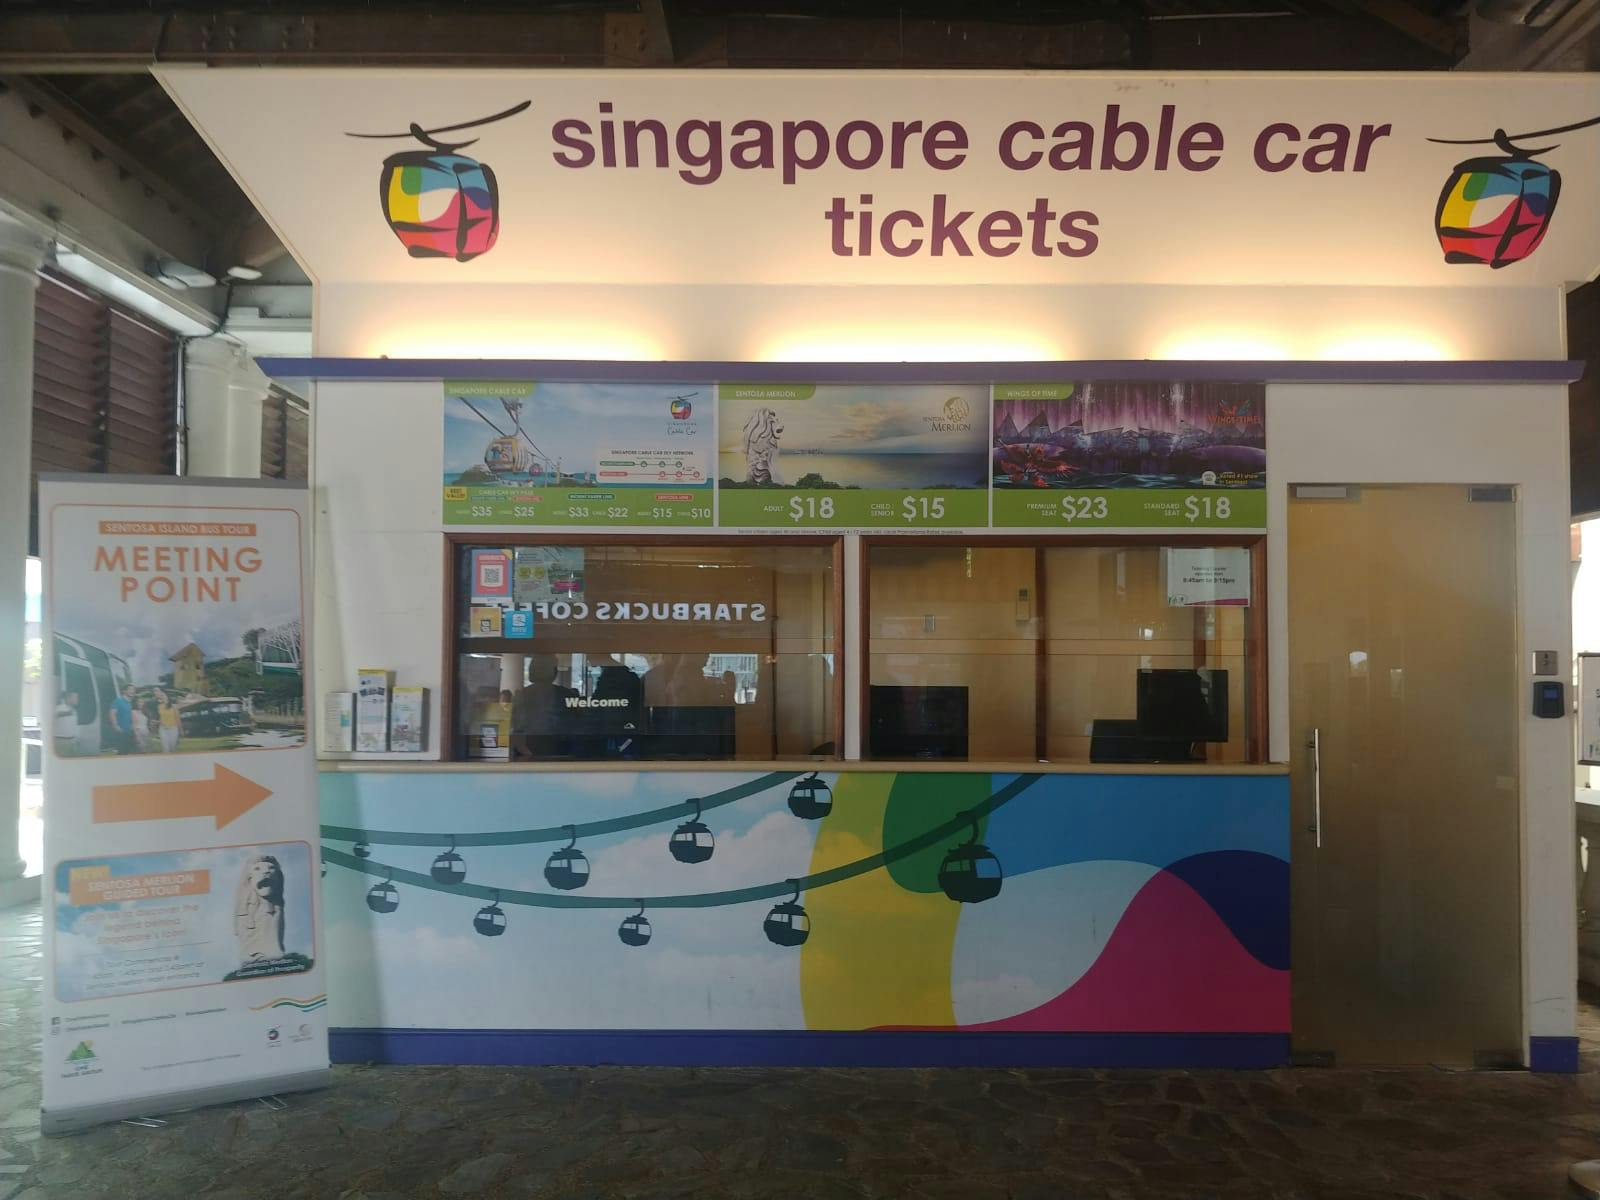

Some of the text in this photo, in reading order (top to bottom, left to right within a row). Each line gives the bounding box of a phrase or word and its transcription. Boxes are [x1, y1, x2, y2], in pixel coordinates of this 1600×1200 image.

[551, 102, 1392, 186] singapore cable car
[824, 193, 1100, 259] tickets
[735, 390, 796, 398] SENTOSA MERLION
[1007, 389, 1058, 397] WINGS OF TIME
[472, 506, 493, 518] $35
[514, 506, 535, 518] $25
[568, 506, 590, 519] $33
[607, 507, 629, 519] $22
[653, 507, 673, 519] $15
[691, 508, 711, 519] $10
[788, 495, 835, 522] $18
[901, 495, 945, 522] $15
[1061, 495, 1109, 522] $23
[1184, 495, 1232, 522] $18
[105, 523, 250, 535] SENTOSA ISLAND BUS TOUR
[95, 545, 263, 574] MEETING
[121, 576, 241, 603] POINT
[565, 697, 629, 708] Welcome
